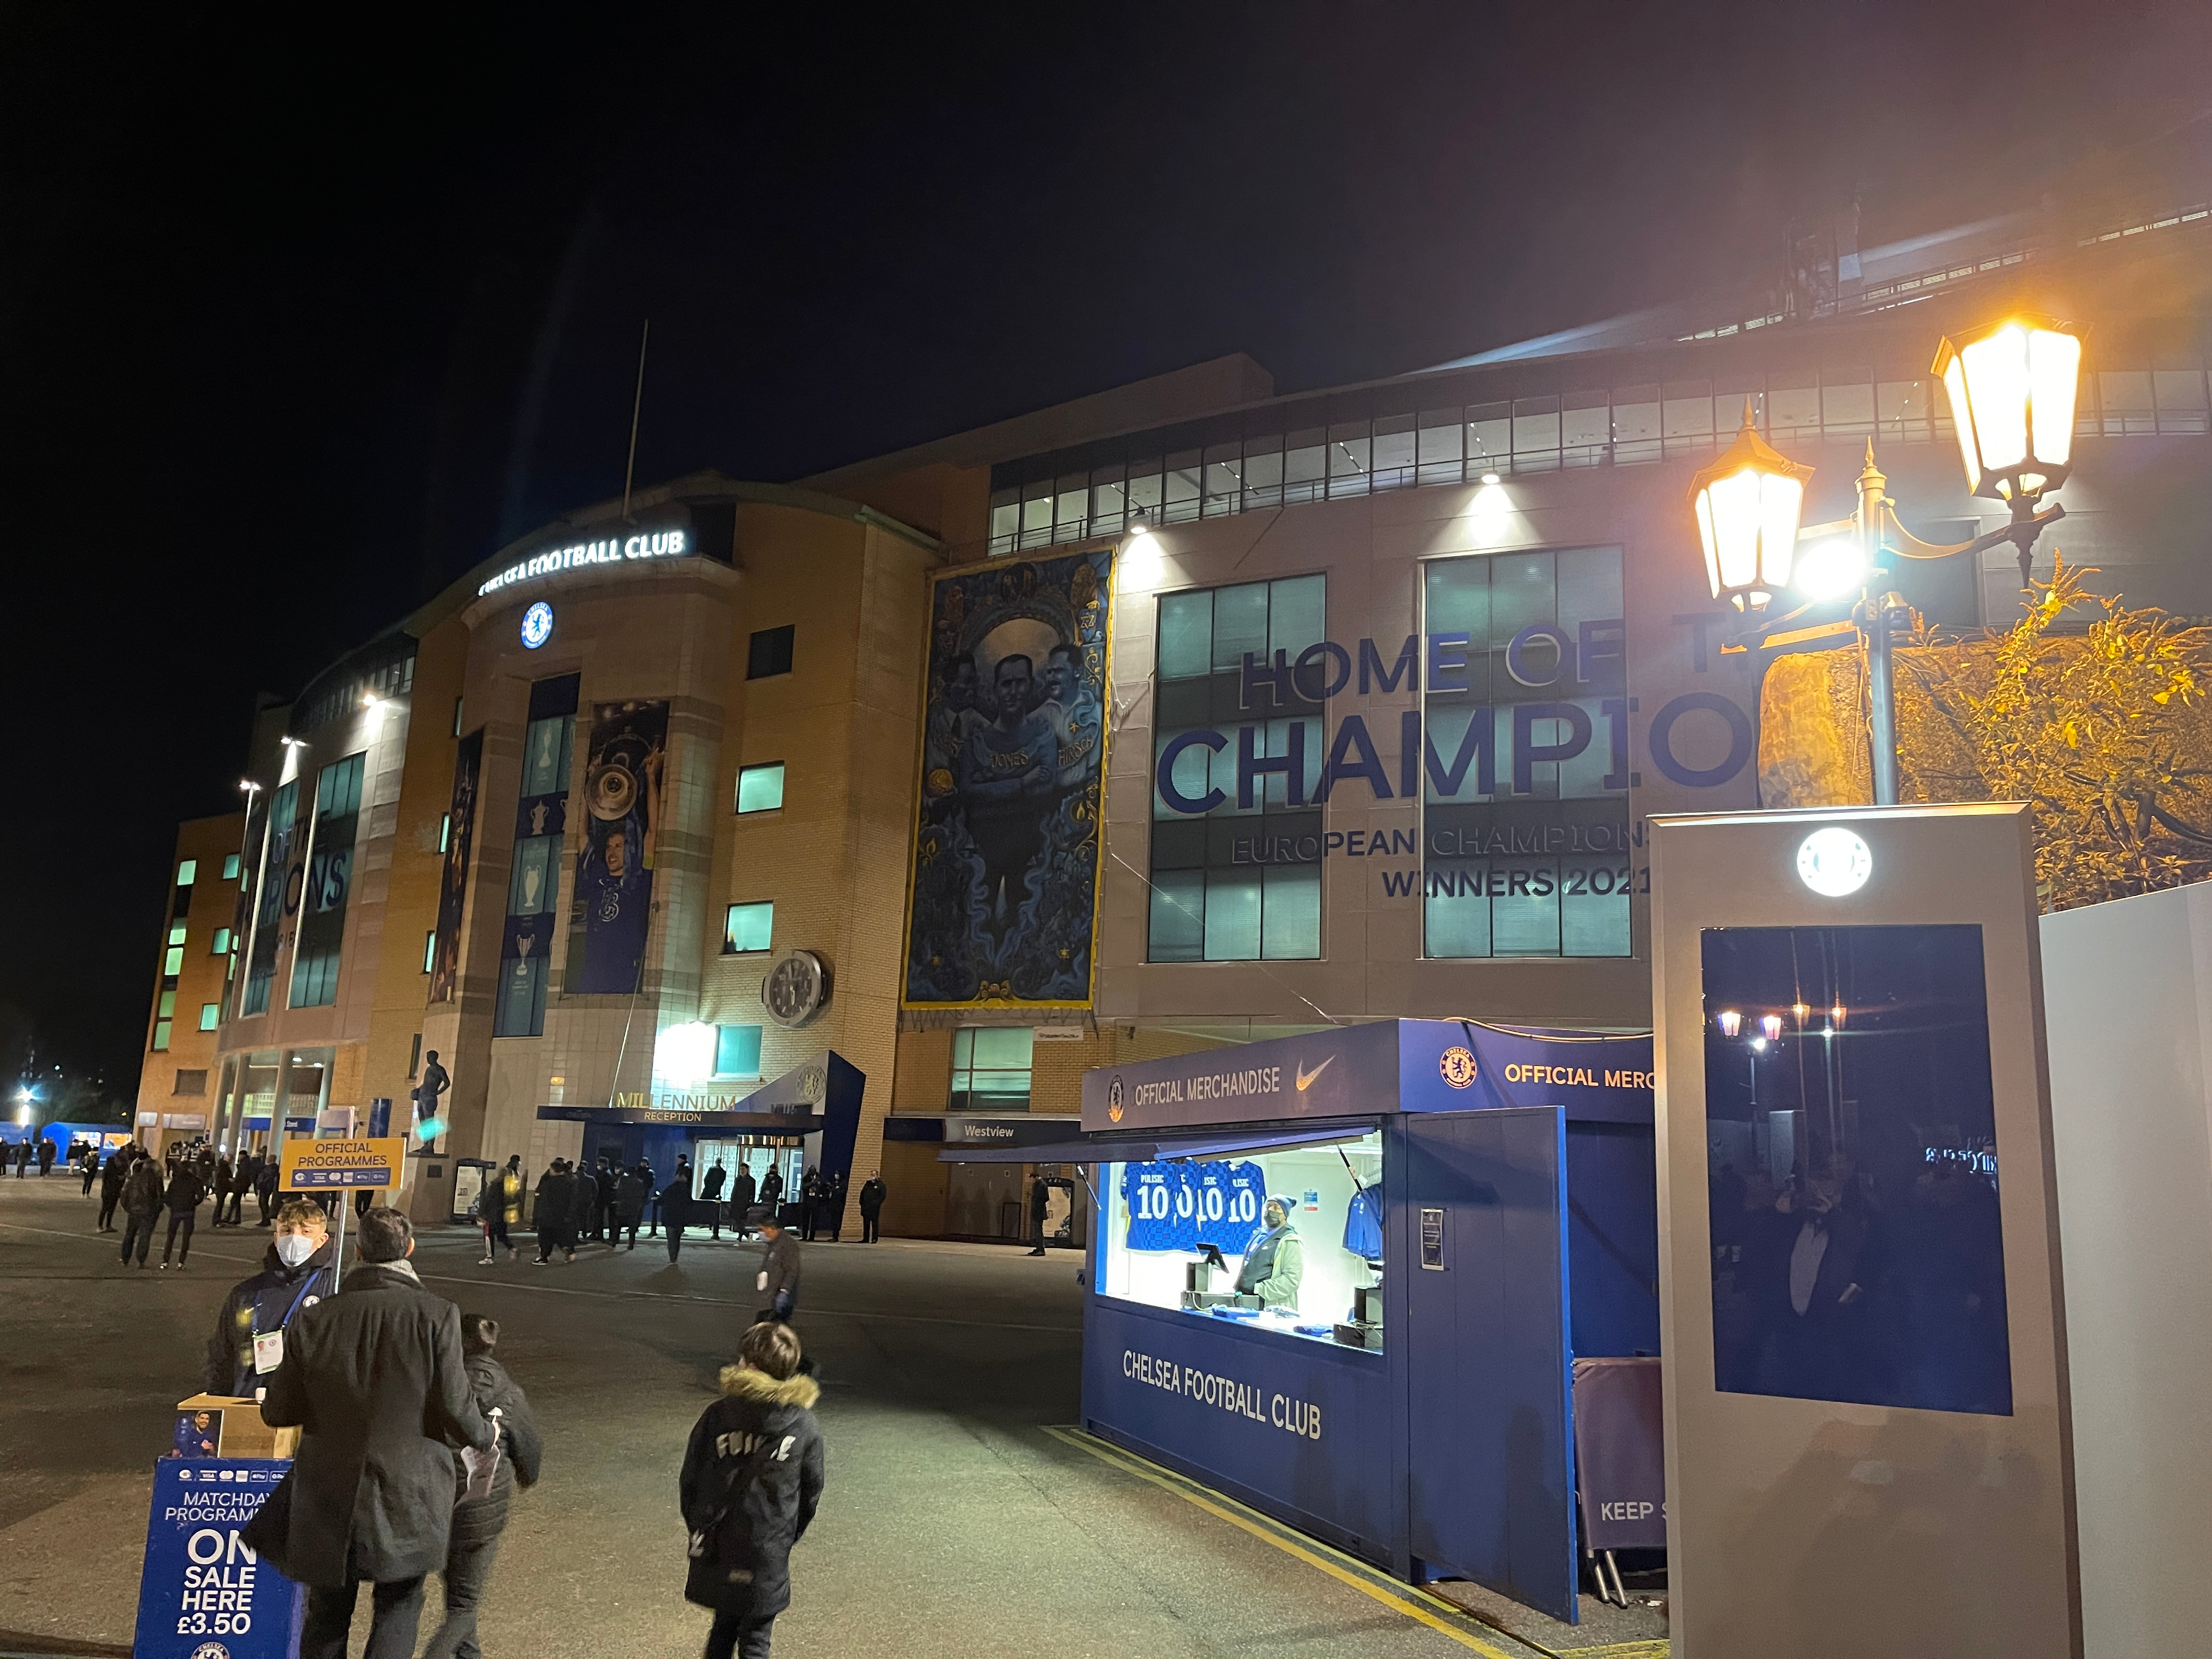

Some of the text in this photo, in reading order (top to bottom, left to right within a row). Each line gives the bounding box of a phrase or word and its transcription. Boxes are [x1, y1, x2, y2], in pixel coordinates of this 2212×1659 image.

[528, 539, 621, 577] FOOTBALL
[624, 531, 684, 559] CLUB
[1238, 633, 1469, 710] HOME
[1505, 618, 1624, 686] OF
[1231, 821, 1649, 864] EUROPEAN CHAMPION
[1566, 866, 1650, 896] 2021
[1446, 1048, 1470, 1058] CHELSEA
[1505, 1063, 1599, 1086] OFFICIAL
[1135, 1066, 1280, 1107] OFFICIAL MERCHANDISE
[616, 1092, 736, 1111] MILLENNIUM
[644, 1111, 702, 1122] RECEPTION
[964, 1125, 1014, 1137] Westview
[315, 1142, 373, 1153] OFFICIAL
[298, 1155, 387, 1167] PROGRAMMES
[1141, 1175, 1164, 1183] PULISIC
[1137, 1185, 1169, 1220] 10
[1228, 1188, 1256, 1222] 10
[1123, 1350, 1321, 1440] CHELSEA FOOTBALL CLUB
[183, 1491, 270, 1507] MATCHDA
[1601, 1502, 1654, 1521] KEEP
[188, 1528, 257, 1565] ON
[184, 1566, 257, 1589] SALE
[182, 1590, 251, 1611] HERE
[177, 1613, 251, 1634] £3.50
